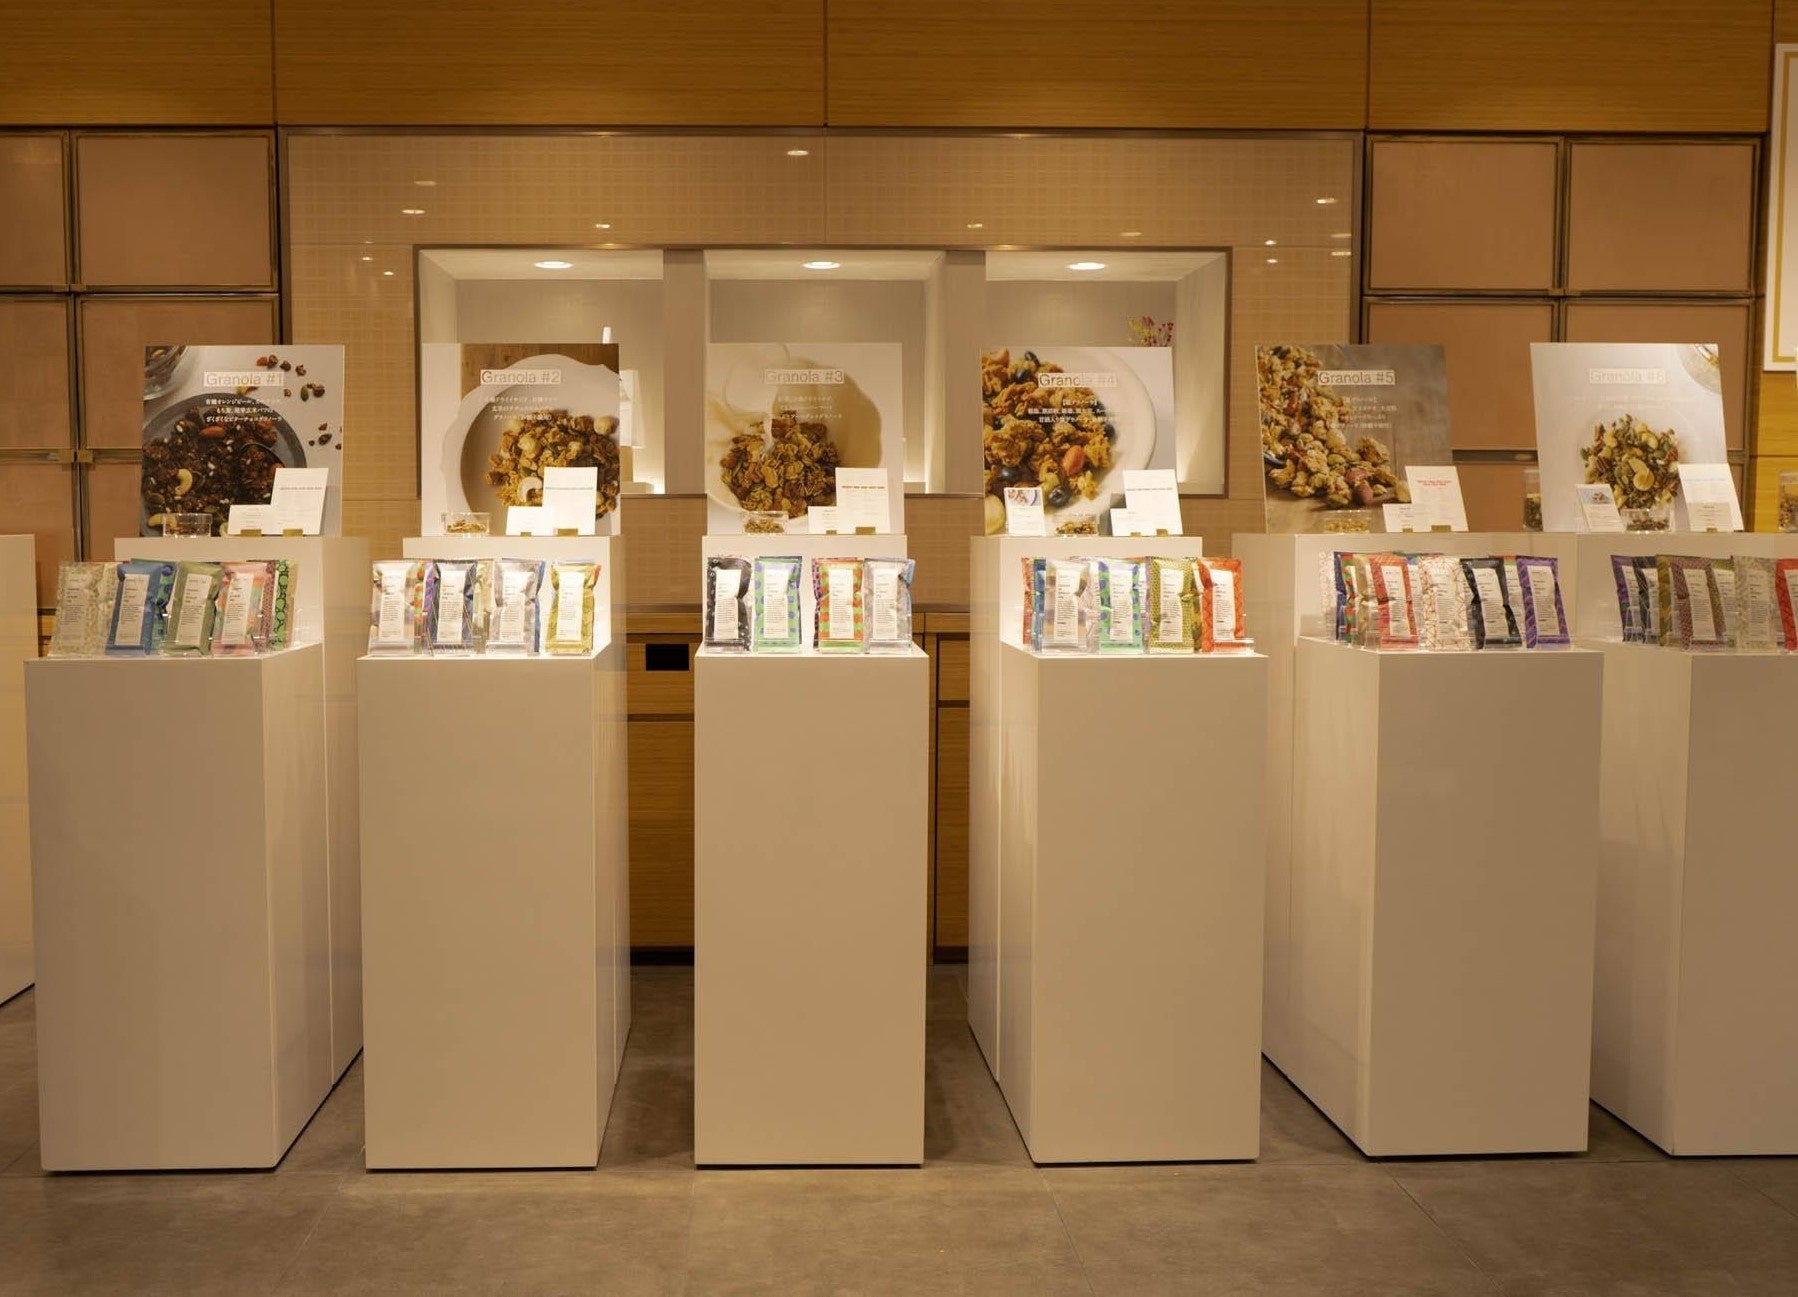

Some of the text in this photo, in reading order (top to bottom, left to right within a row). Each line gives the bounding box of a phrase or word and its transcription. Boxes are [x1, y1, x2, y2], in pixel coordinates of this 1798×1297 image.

[206, 372, 283, 385] Granola #1
[481, 370, 560, 383] Granola #2
[765, 370, 843, 383] Granola #3
[1319, 371, 1394, 384] Granola #5
